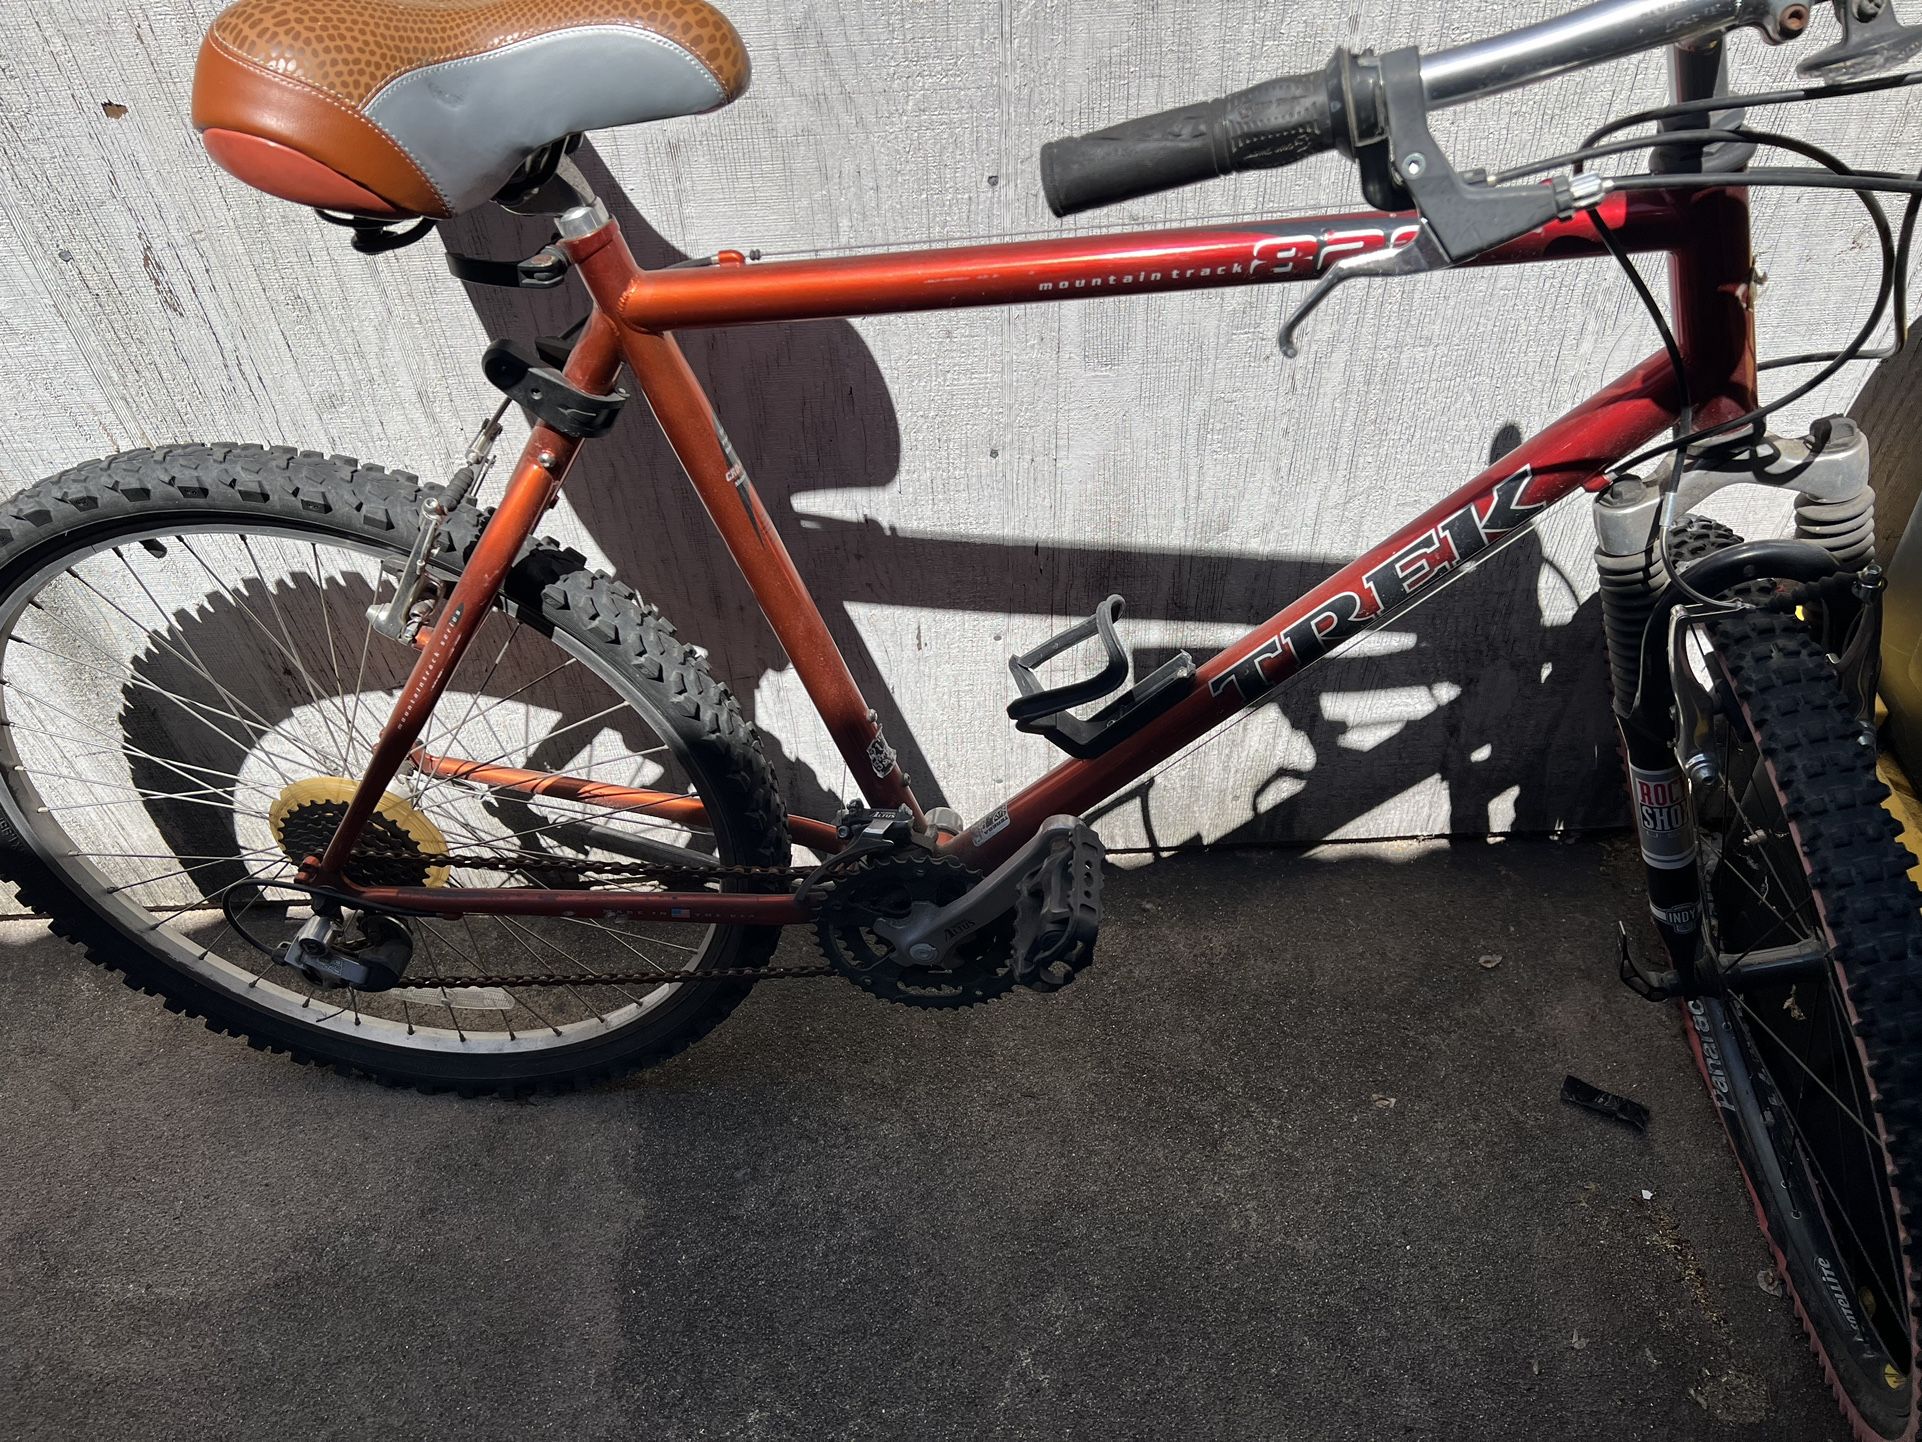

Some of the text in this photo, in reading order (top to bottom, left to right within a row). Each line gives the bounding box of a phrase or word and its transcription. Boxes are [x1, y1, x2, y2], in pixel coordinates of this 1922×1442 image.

[1207, 463, 1547, 702] TREK
[1638, 777, 1686, 806] ROC
[1640, 803, 1687, 831] SHO
[1668, 906, 1696, 924] INDY
[1687, 1000, 1736, 1111] Panarac
